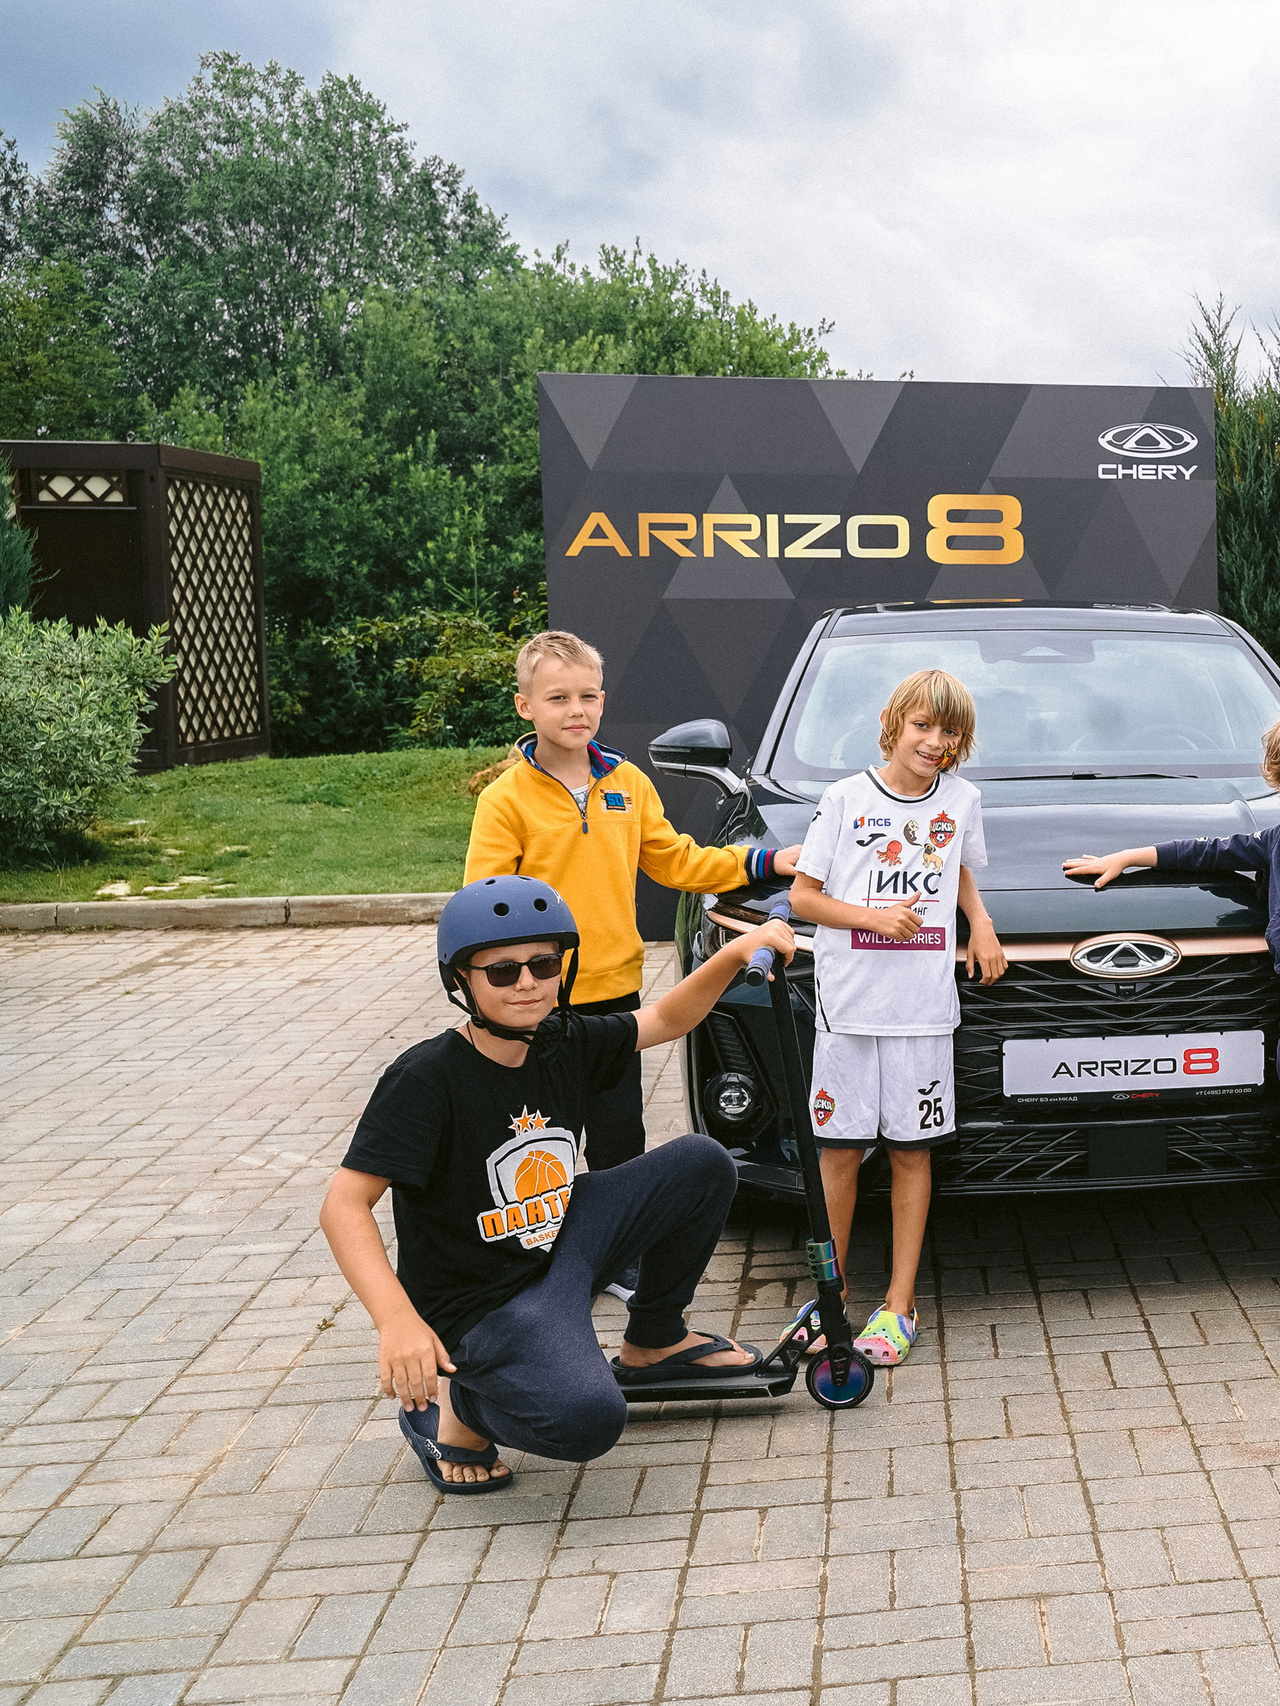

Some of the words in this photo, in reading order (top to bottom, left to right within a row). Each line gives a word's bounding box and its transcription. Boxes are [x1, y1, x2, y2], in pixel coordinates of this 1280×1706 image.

[1097, 463, 1198, 481] CHERY
[565, 512, 910, 558] ARRIZO
[926, 493, 1025, 565] 8
[867, 818, 891, 827] ПСБ
[876, 870, 942, 895] ИКС
[1051, 1056, 1177, 1078] ARRIZO
[1183, 1047, 1220, 1075] 8
[918, 1097, 944, 1130] 25
